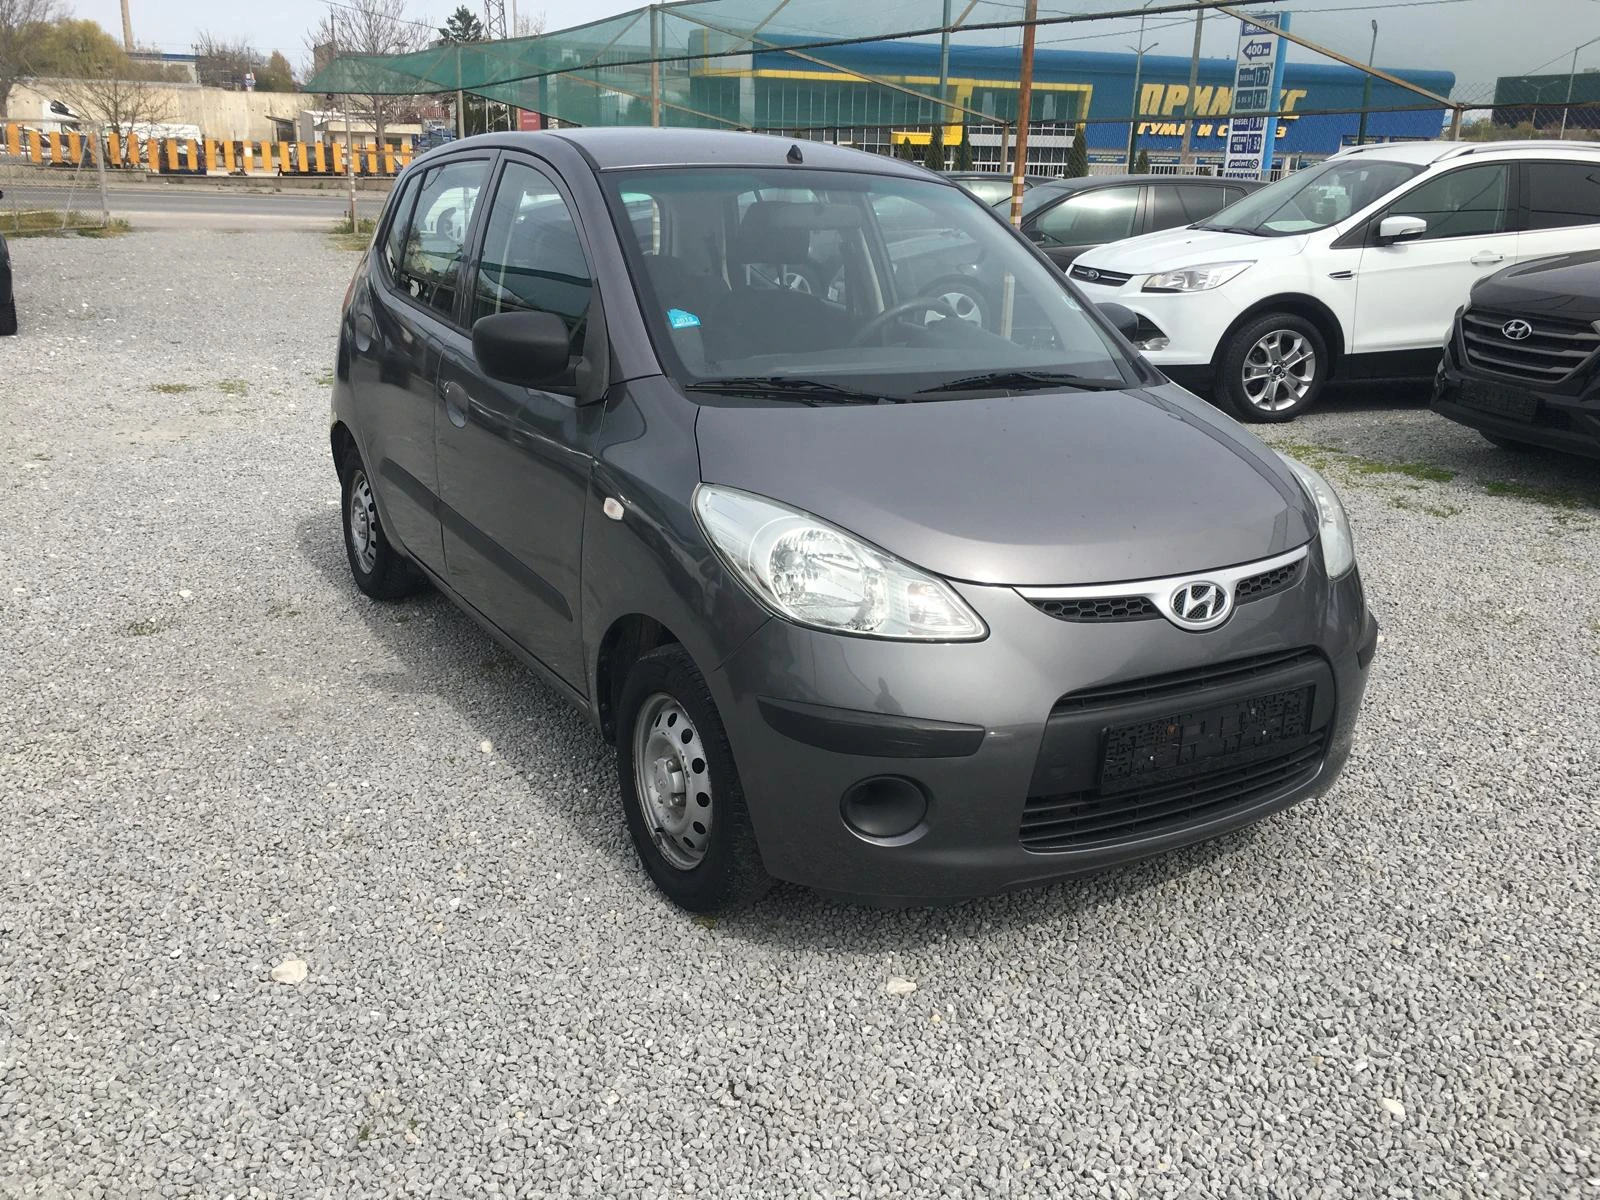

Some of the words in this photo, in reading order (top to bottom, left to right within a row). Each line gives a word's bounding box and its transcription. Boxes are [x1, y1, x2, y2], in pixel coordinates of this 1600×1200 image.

[1246, 44, 1262, 55] 400
[1233, 118, 1249, 126] DIESEL
[1197, 124, 1213, 136] И
[1230, 160, 1249, 168] point
